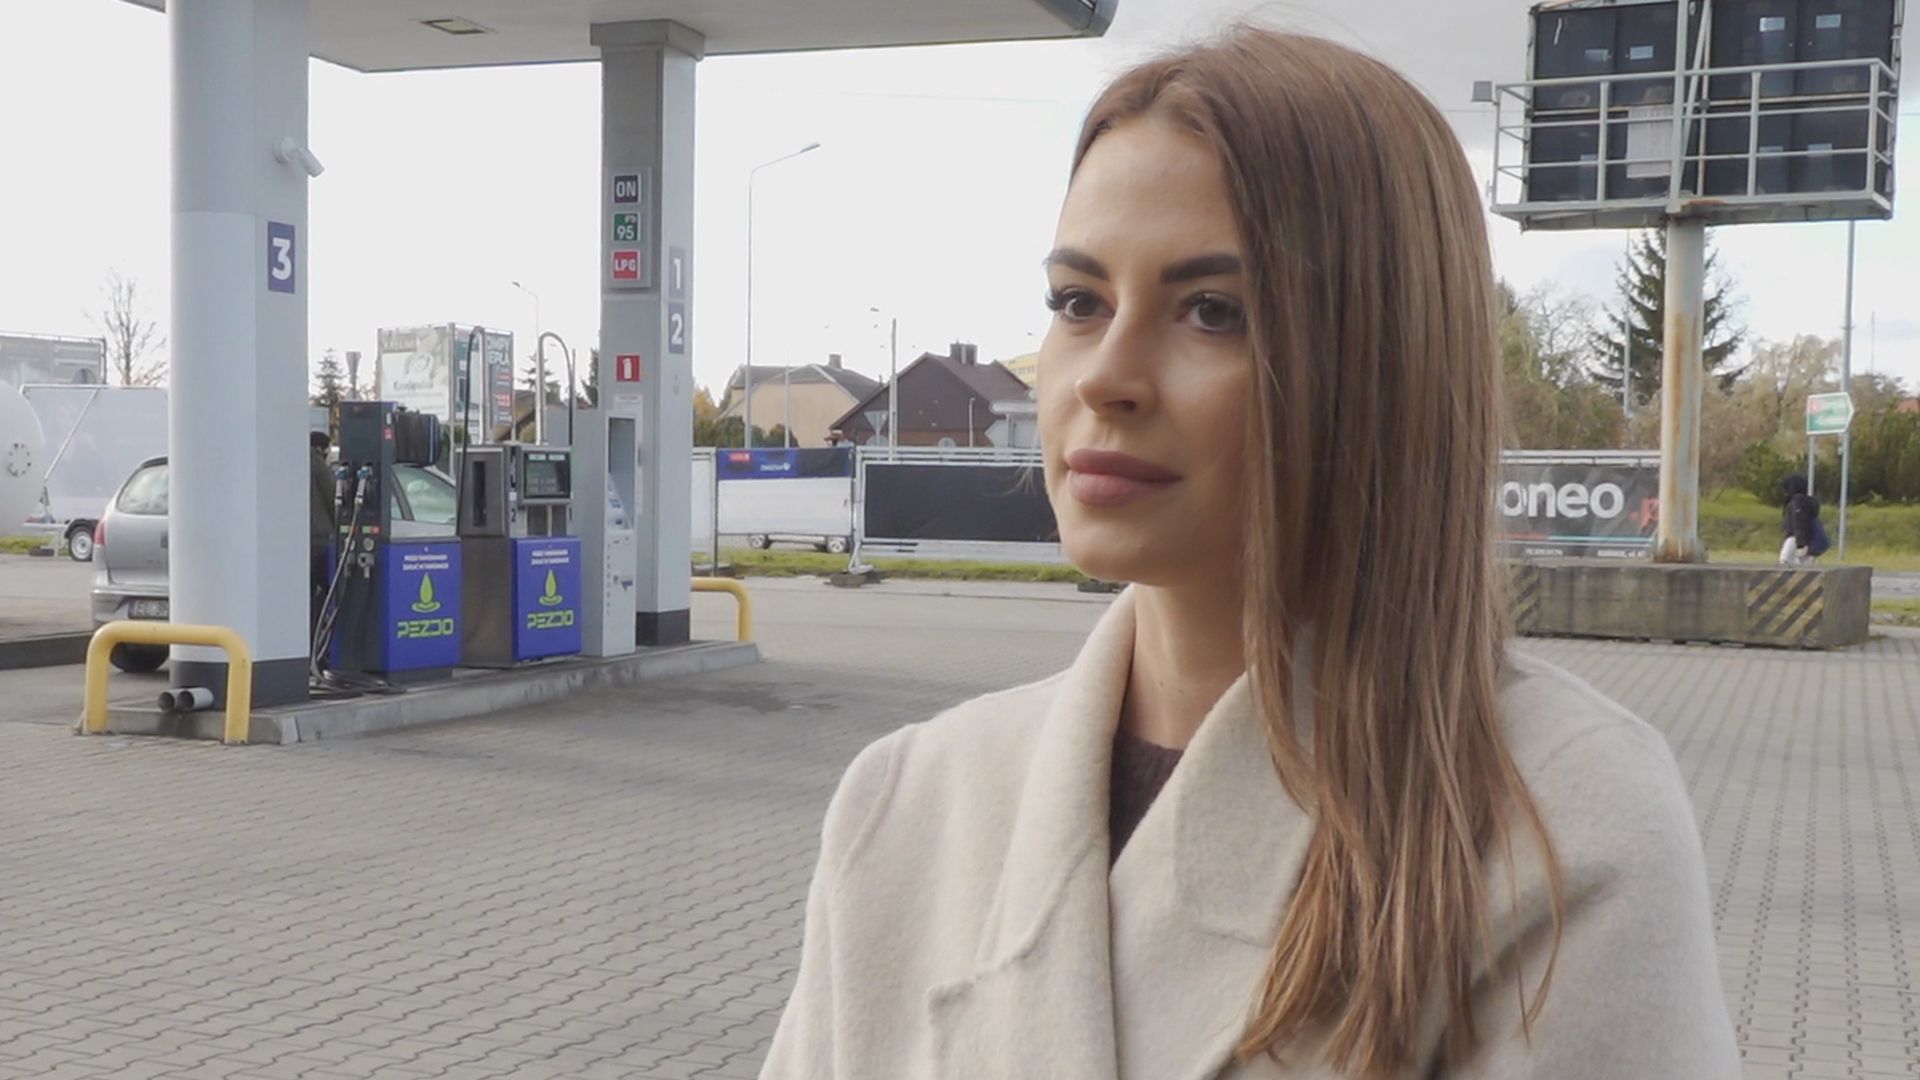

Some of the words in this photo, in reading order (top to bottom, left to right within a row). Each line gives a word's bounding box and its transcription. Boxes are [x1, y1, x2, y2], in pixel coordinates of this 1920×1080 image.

[616, 181, 636, 198] ON
[617, 226, 634, 240] 95
[272, 237, 292, 281] 3
[614, 258, 637, 272] LPG
[673, 258, 682, 290] 1
[671, 312, 683, 345] 2
